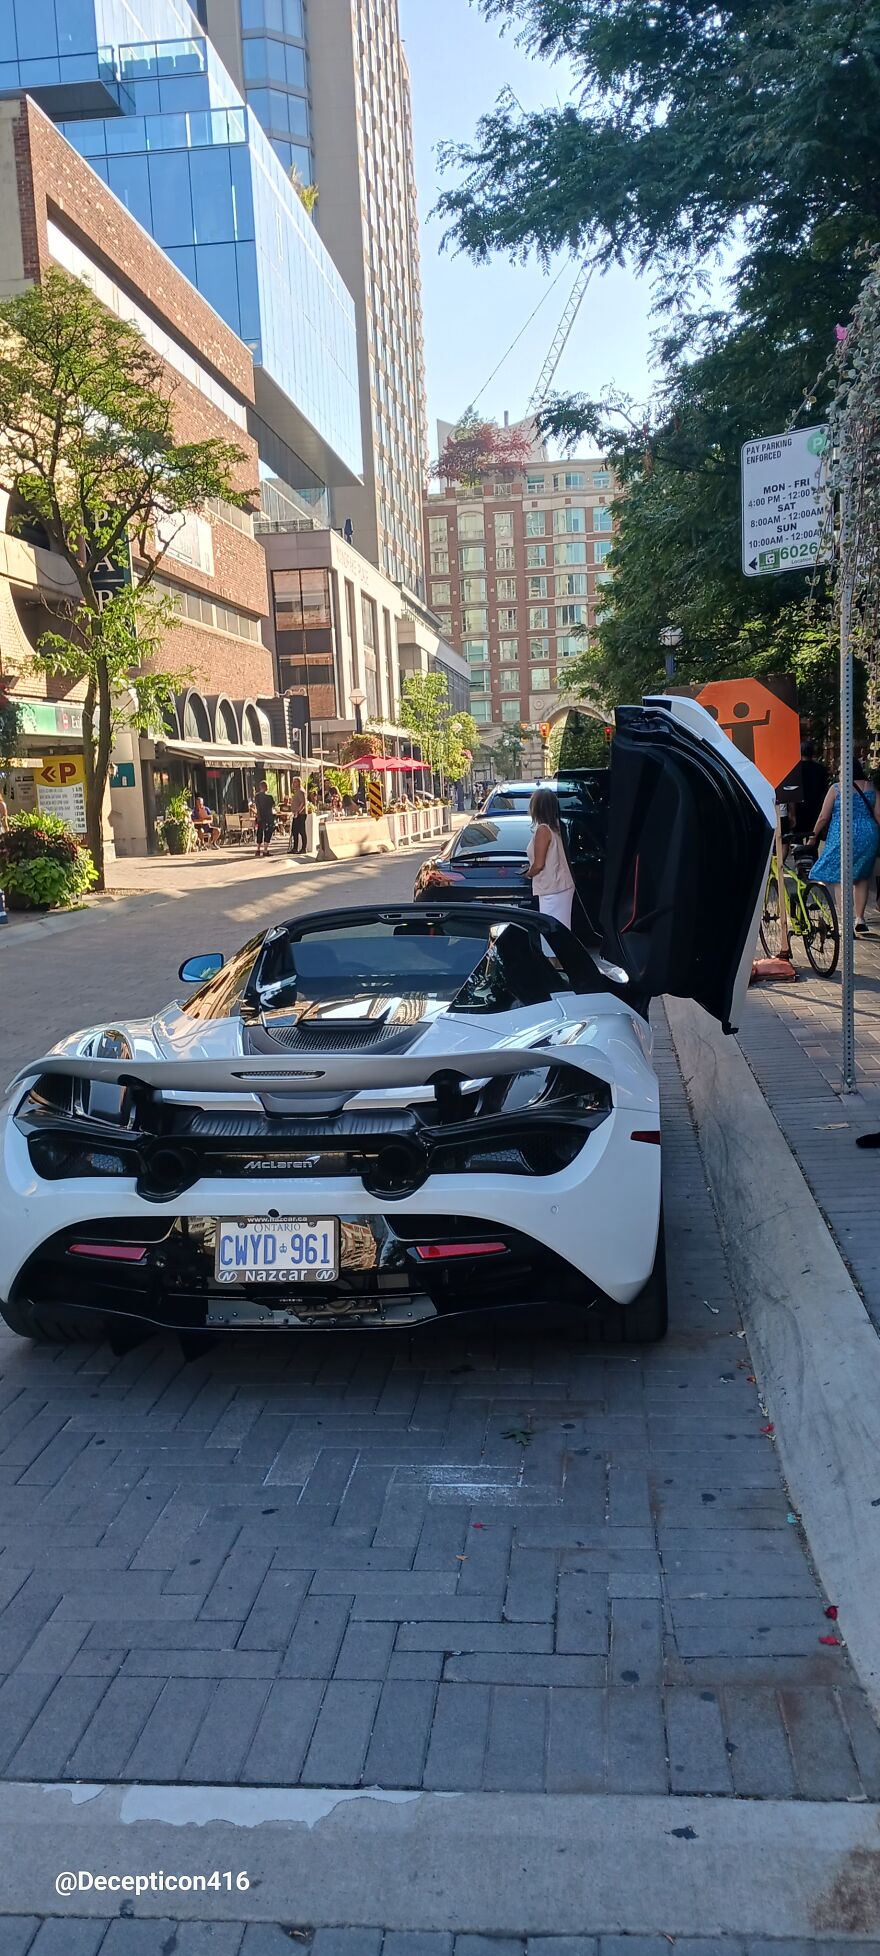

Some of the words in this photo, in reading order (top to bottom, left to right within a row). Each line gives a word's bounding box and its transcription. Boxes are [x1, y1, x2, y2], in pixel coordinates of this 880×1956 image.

[746, 444, 760, 456] PAY
[761, 438, 793, 453] PARKING
[746, 450, 782, 465] ENFORCED
[763, 482, 786, 495] MON
[794, 477, 810, 489] FRI
[748, 496, 766, 508] 4:00
[767, 494, 780, 505] PM
[788, 488, 810, 501] 12:00
[777, 501, 797, 513] SAT
[750, 514, 781, 528] 8:00AM
[788, 506, 825, 521] 12:00AM
[776, 522, 797, 533] SUN
[748, 534, 783, 549] 10:00AM
[780, 541, 819, 560] 6026
[791, 556, 812, 565] Location
[59, 762, 77, 784] P
[244, 1160, 313, 1169] McLaren
[254, 1223, 301, 1233] ONTARIO
[220, 1234, 277, 1266] CWYD
[290, 1233, 330, 1265] 961
[245, 1270, 308, 1282] Nazcar
